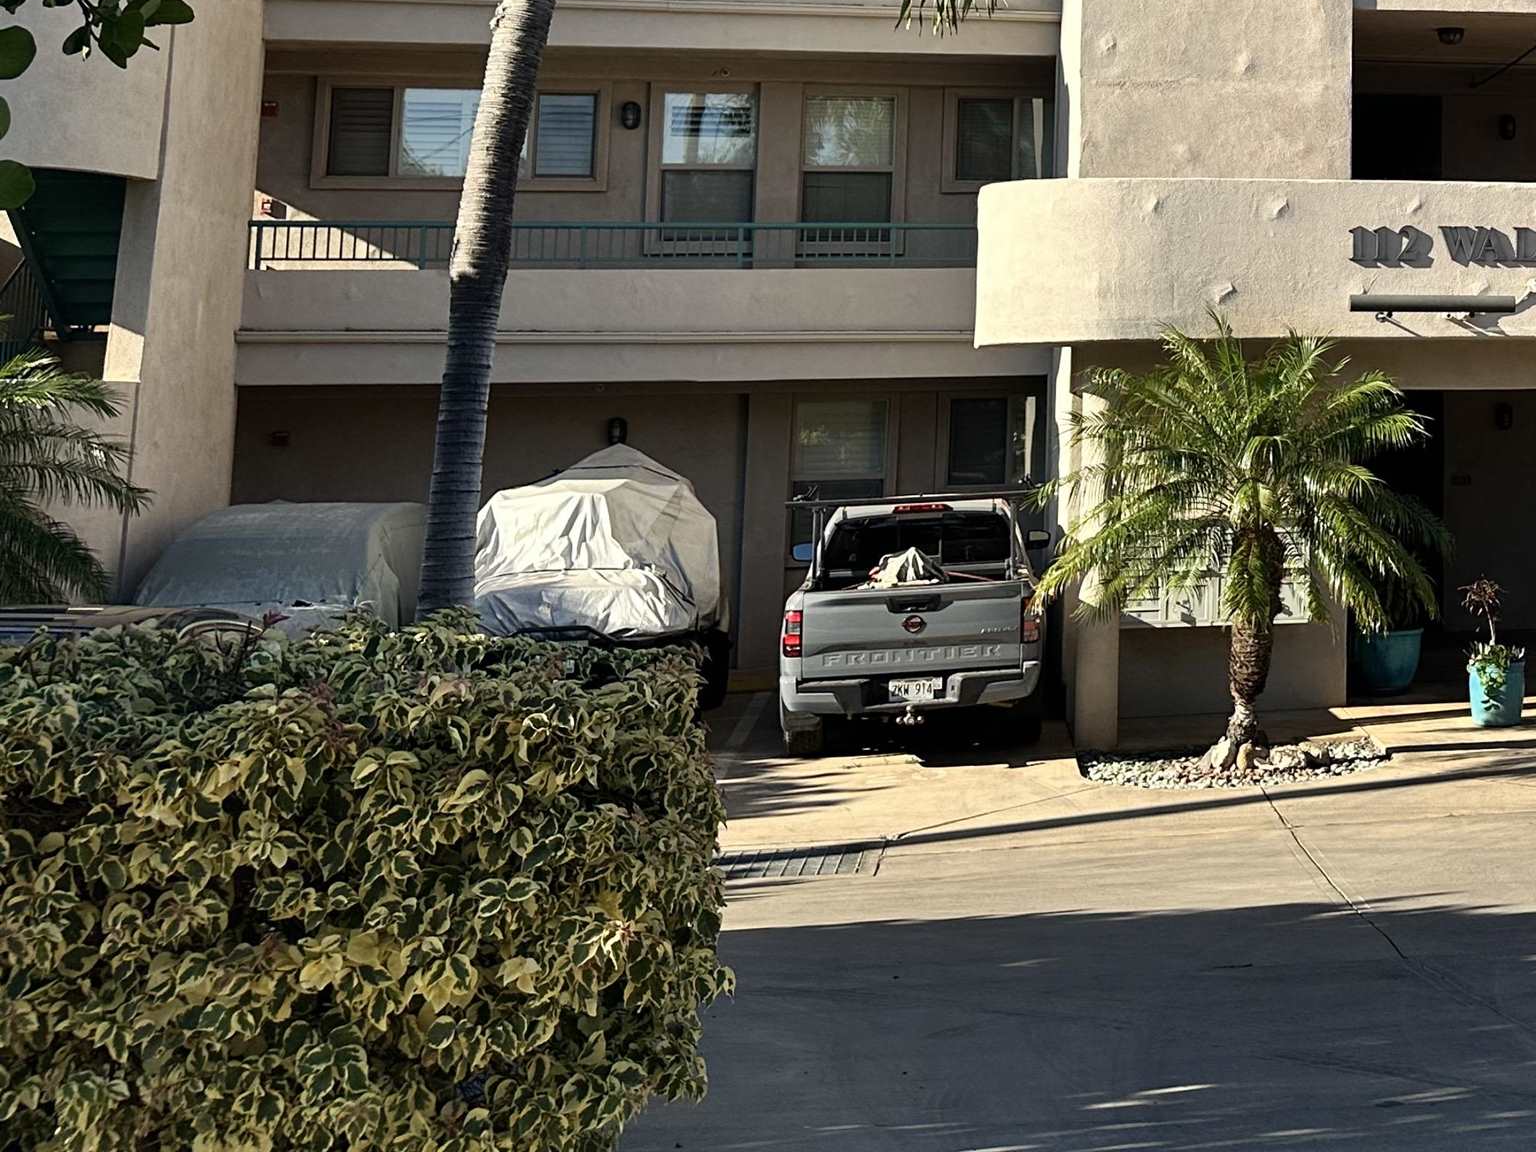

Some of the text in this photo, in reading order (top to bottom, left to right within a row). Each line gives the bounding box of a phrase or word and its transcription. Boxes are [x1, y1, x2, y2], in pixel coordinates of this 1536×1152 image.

[1349, 225, 1431, 266] 112
[823, 644, 1001, 667] FRONTIER
[915, 682, 932, 695] 914
